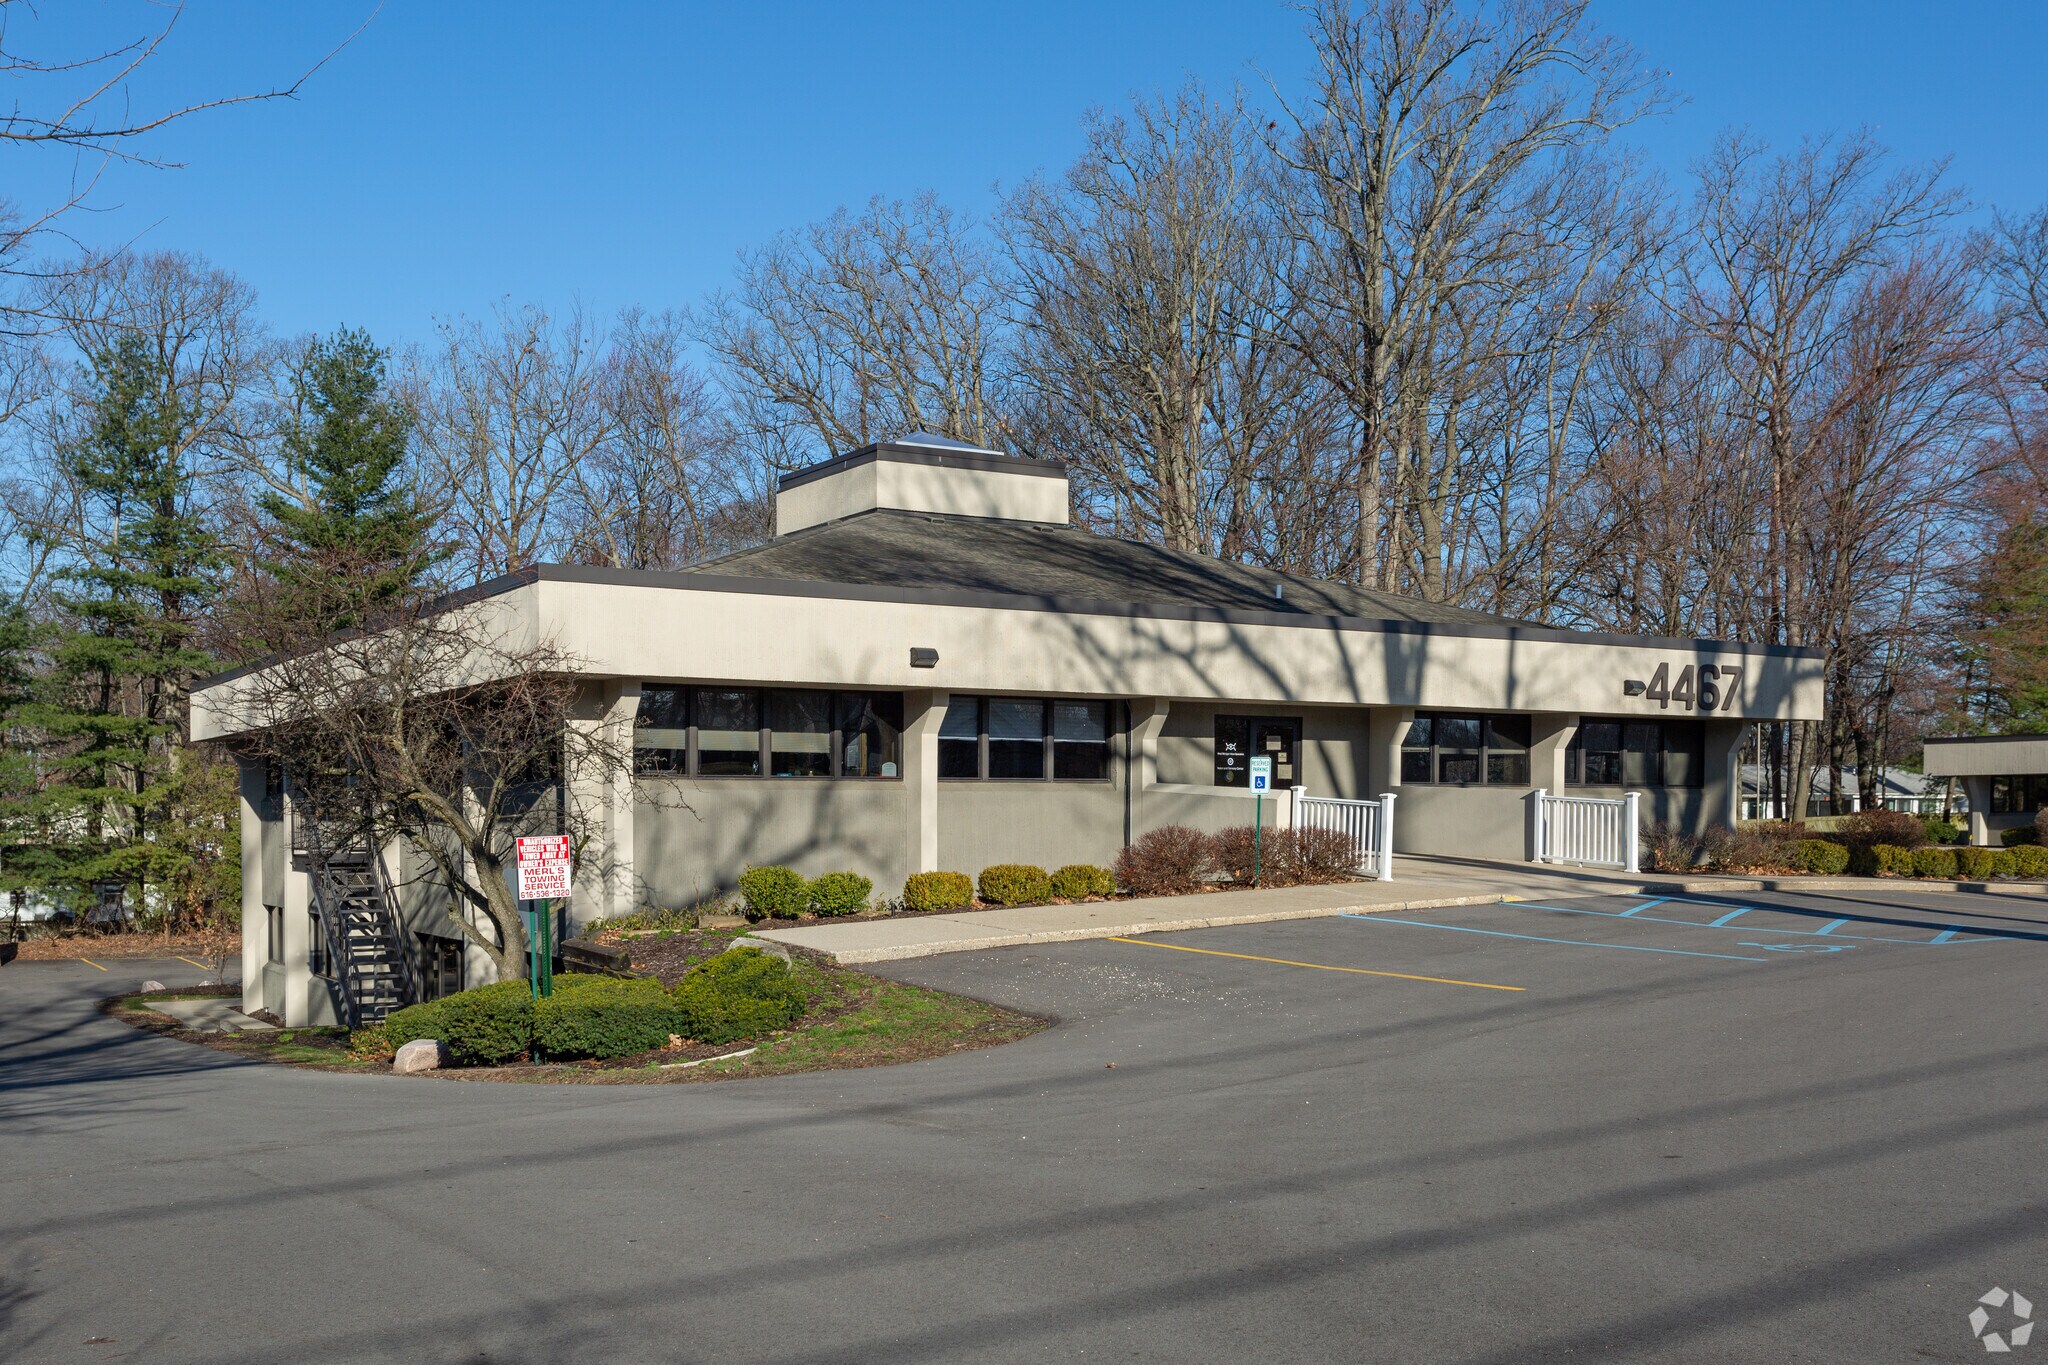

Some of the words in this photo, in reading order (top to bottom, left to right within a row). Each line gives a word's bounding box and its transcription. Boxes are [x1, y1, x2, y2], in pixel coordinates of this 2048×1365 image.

[1646, 662, 1743, 711] 4467
[523, 837, 562, 845] UNAUTHORIZED
[520, 845, 545, 853] VEHICLES
[546, 844, 559, 852] WILL
[560, 843, 568, 851] BE
[522, 852, 540, 860] TOWED
[542, 851, 557, 859] AWAY
[519, 859, 544, 868] OWNER'S
[545, 858, 569, 866] EXPENSE
[524, 867, 564, 875] MERL'S
[525, 875, 565, 883] TOWING
[525, 882, 565, 890] SERVICE
